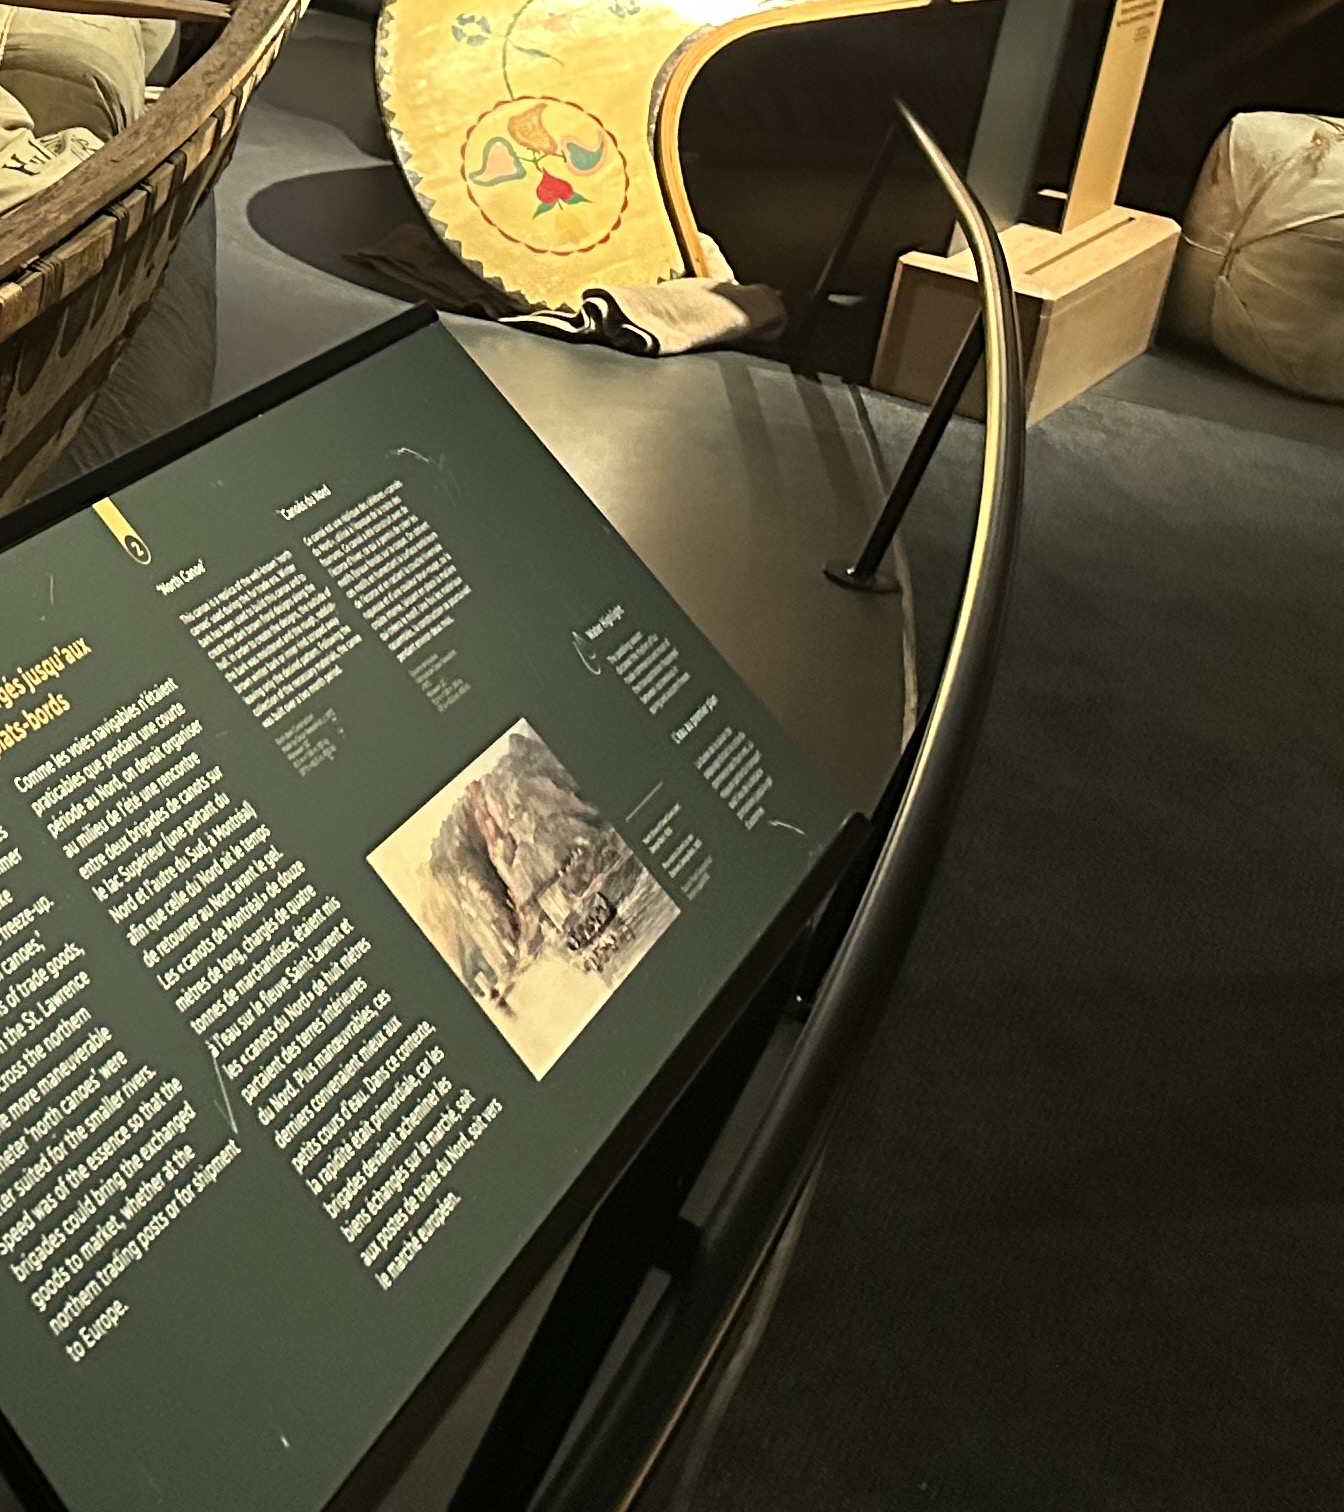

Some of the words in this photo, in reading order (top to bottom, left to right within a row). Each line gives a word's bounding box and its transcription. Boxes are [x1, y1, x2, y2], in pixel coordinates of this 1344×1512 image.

[304, 494, 317, 507] du
[311, 483, 332, 502] Nord
[130, 541, 145, 557] 2
[12, 759, 57, 793] Comme
[49, 749, 72, 769] les
[65, 733, 96, 758] voies
[90, 702, 142, 743] navigables
[30, 770, 87, 818] praticables
[81, 757, 105, 780] que
[100, 731, 143, 769] pendant
[136, 720, 159, 741] une
[154, 701, 187, 729] courte
[45, 802, 88, 840] période
[82, 792, 101, 811] au
[93, 773, 128, 802] Nord,
[121, 765, 139, 783] on
[133, 744, 167, 774] devait
[160, 718, 204, 755] organiser
[61, 839, 81, 859] au
[75, 818, 110, 849] milieu
[104, 808, 123, 827] de
[137, 780, 161, 803] une
[155, 750, 201, 790] rencontre
[1, 1021, 28, 1047] the
[20, 1009, 44, 1031] St.
[35, 970, 91, 1018] Lawrence
[4, 985, 21, 1008] of
[14, 966, 50, 998] trade
[45, 941, 87, 979] goods,
[6, 1087, 42, 1121] more
[35, 1026, 113, 1096] maneuverable
[21, 1043, 47, 1068] the
[41, 1006, 92, 1053] northern
[97, 1049, 128, 1080] were
[12, 1152, 53, 1198] suited
[45, 1140, 69, 1166] for
[63, 1124, 89, 1150] the
[83, 1089, 126, 1133] smaller
[120, 1064, 157, 1099] rivers.
[30, 1192, 59, 1222] was
[53, 1175, 71, 1201] of
[63, 1163, 91, 1189] the
[85, 1124, 132, 1171] essence
[126, 1112, 145, 1134] so
[137, 1091, 167, 1121] that
[158, 1076, 183, 1101] the
[9, 1227, 67, 1283] brigades
[61, 1193, 97, 1235] could
[88, 1170, 128, 1207] bring
[118, 1153, 144, 1179] the
[138, 1098, 197, 1162] exchanged
[30, 1265, 72, 1313] goods
[63, 1253, 84, 1275] to
[78, 1214, 127, 1262] market,
[118, 1171, 166, 1221] whether
[160, 1159, 179, 1182] at
[171, 1144, 196, 1169] the
[48, 1278, 103, 1337] northern
[95, 1239, 143, 1287] trading
[135, 1210, 170, 1252] posts
[164, 1197, 181, 1220] or
[173, 1183, 196, 1208] for
[191, 1138, 242, 1193] shipment
[64, 1340, 86, 1363] to
[77, 1299, 130, 1349] Europe.
